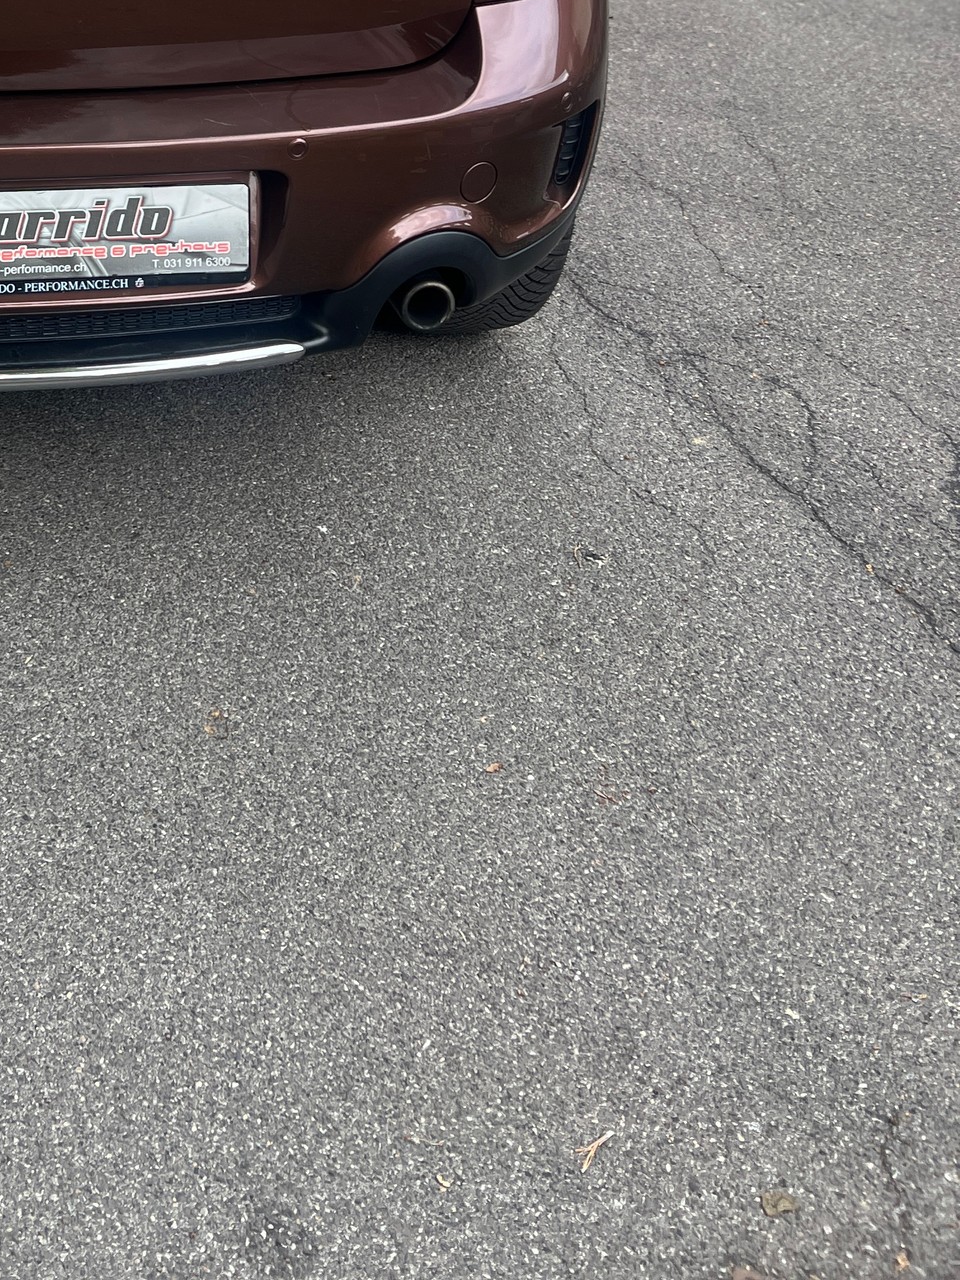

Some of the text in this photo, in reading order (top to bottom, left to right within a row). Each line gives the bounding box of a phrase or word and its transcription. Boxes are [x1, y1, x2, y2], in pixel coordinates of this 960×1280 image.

[152, 256, 232, 269] T. 031 911 6300
[24, 278, 129, 293] PERFORMANCE.CH
